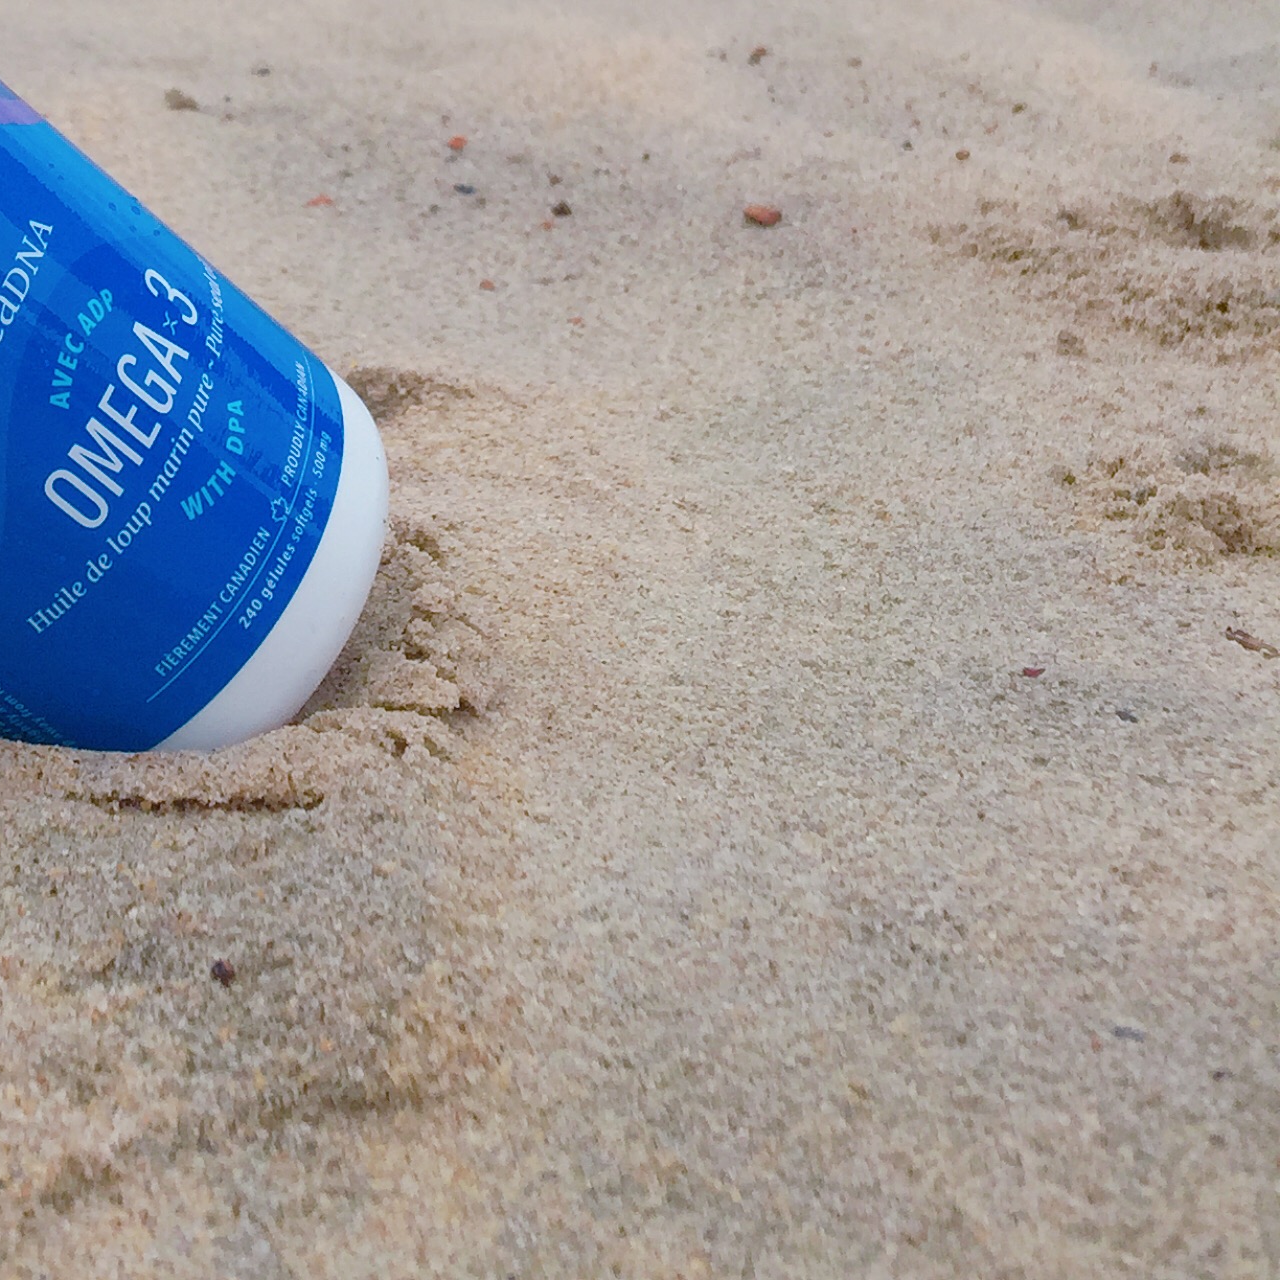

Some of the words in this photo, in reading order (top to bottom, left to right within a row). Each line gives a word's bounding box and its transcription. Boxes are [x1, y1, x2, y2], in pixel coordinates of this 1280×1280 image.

[49, 333, 85, 410] AVEC
[76, 288, 113, 336] ADP
[26, 581, 87, 634] Huile
[86, 553, 114, 584] de
[106, 501, 153, 556] loup
[148, 427, 195, 502] marin
[187, 372, 214, 433] pure
[205, 311, 224, 359] Pure
[154, 601, 224, 677] FIÈREMENT
[219, 526, 271, 604] CANADIEN
[280, 424, 307, 488] PROUDLY
[295, 361, 309, 421] CANADIAN
[180, 460, 237, 520] WITH
[225, 400, 246, 455] DPA
[238, 599, 263, 629] 240
[261, 544, 296, 601] gélules
[291, 487, 319, 543] softgels
[312, 451, 327, 479] 500
[320, 430, 333, 452] mg
